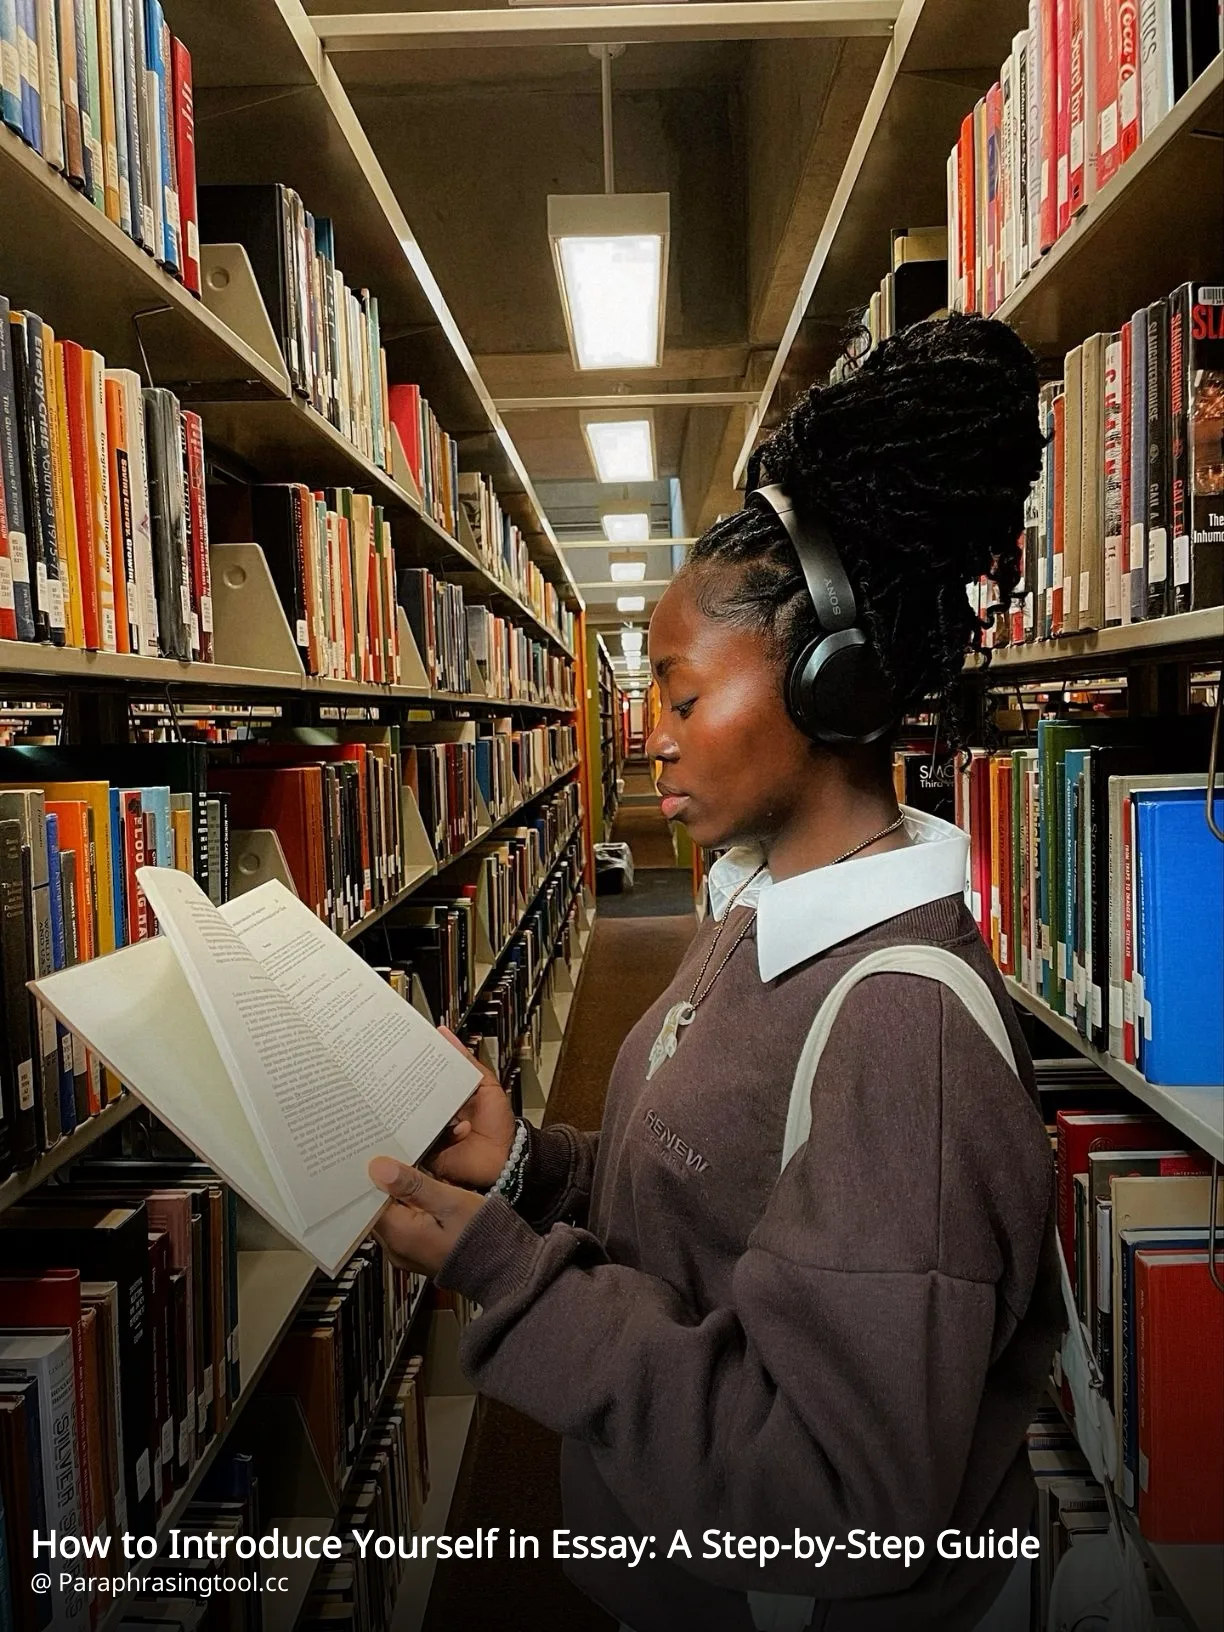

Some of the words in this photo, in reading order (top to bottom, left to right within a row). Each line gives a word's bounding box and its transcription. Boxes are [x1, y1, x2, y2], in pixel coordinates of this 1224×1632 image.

[34, 335, 46, 402] Energy
[1147, 321, 1159, 422] SLAUGHTERHOUSE
[1171, 312, 1183, 416] SLAUGHTERHOUSE
[38, 401, 50, 450] Crisis
[1104, 369, 1117, 476] CHAIN
[42, 453, 55, 506] Volume
[100, 431, 108, 492] Energizing
[120, 457, 130, 495] Saving
[103, 495, 112, 575] Neoliberalism
[823, 577, 841, 617] SONY
[1125, 882, 1132, 892] TO
[52, 1412, 74, 1508] SILVER
